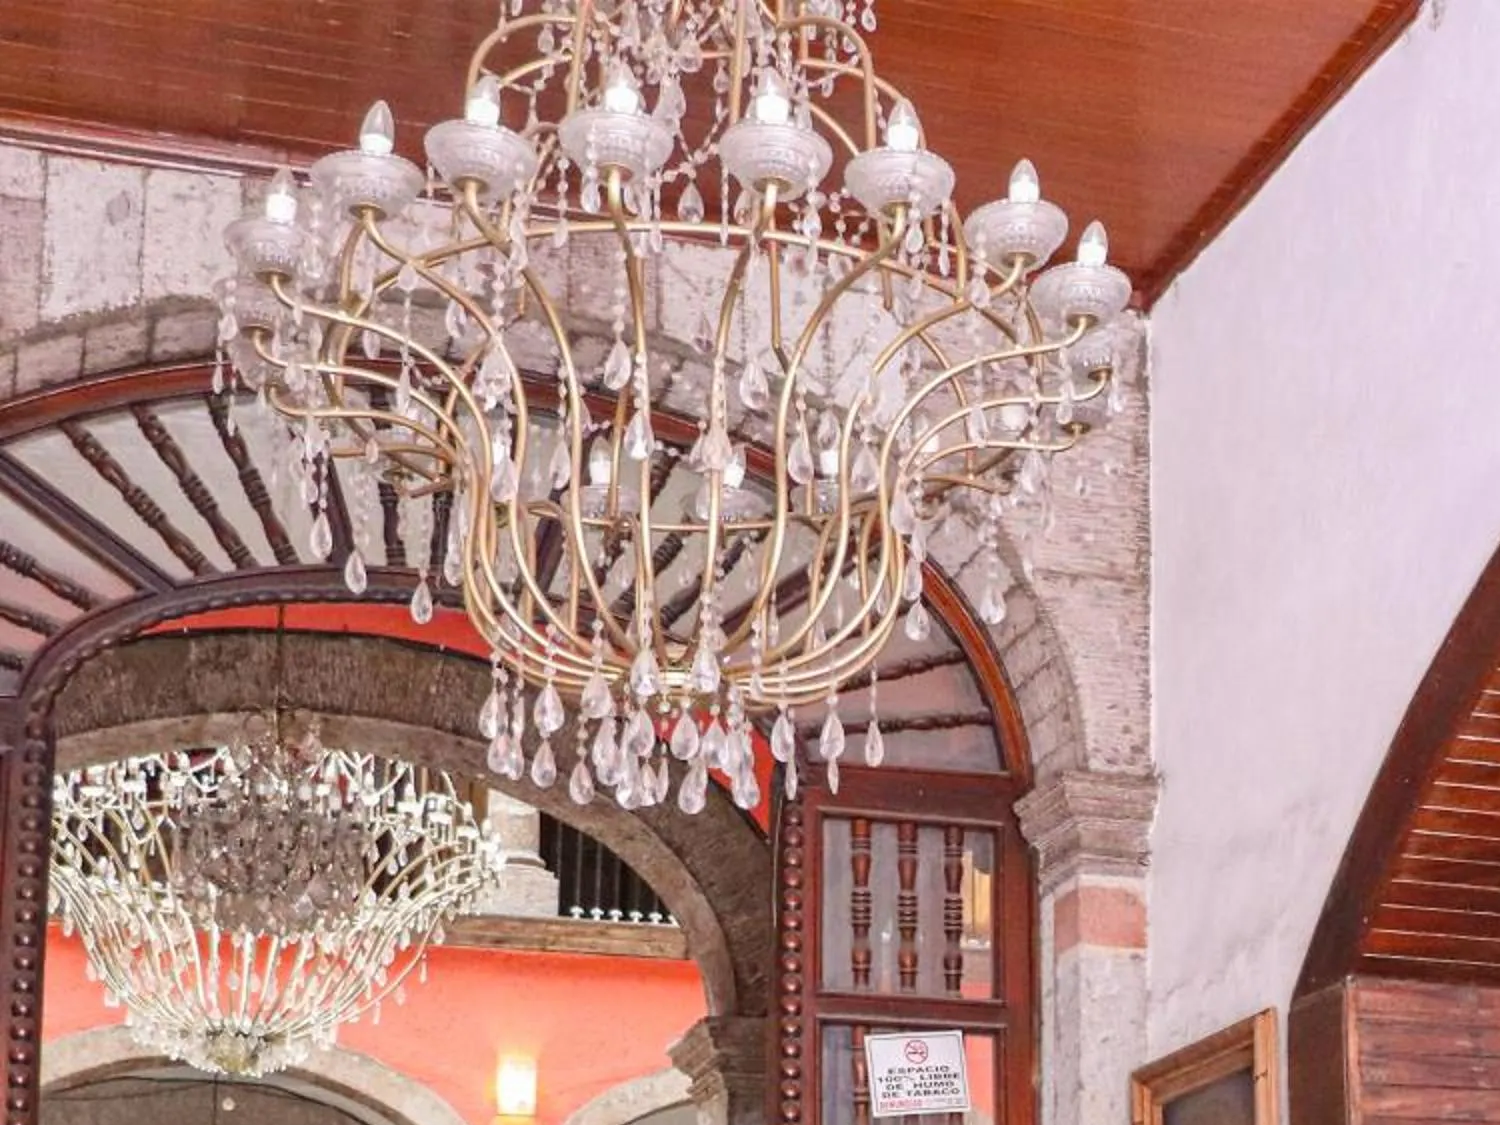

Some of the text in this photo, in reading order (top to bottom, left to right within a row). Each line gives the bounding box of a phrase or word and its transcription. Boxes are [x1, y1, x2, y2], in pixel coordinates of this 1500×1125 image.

[887, 1065, 950, 1074] ESPACIO
[886, 1080, 955, 1091] DE HUMO
[882, 1087, 961, 1099] DE TABACO
